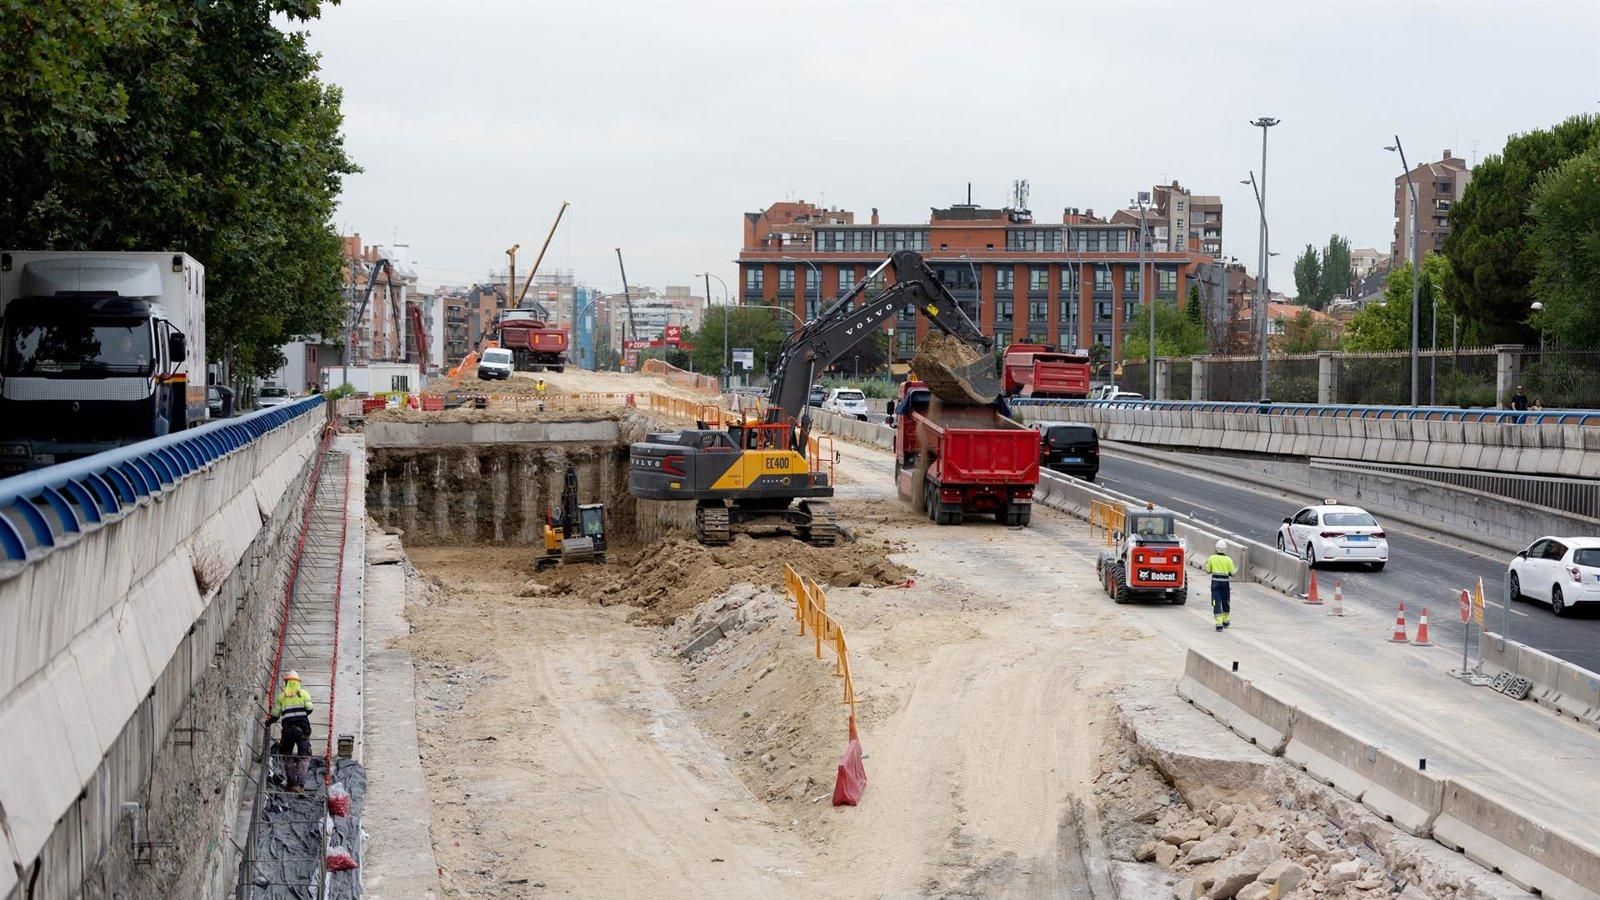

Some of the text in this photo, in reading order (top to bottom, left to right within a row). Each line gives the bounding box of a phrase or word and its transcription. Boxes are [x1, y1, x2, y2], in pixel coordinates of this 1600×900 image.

[845, 303, 893, 335] VOLVO
[766, 457, 790, 469] EC400
[1151, 572, 1176, 580] Bobcat
